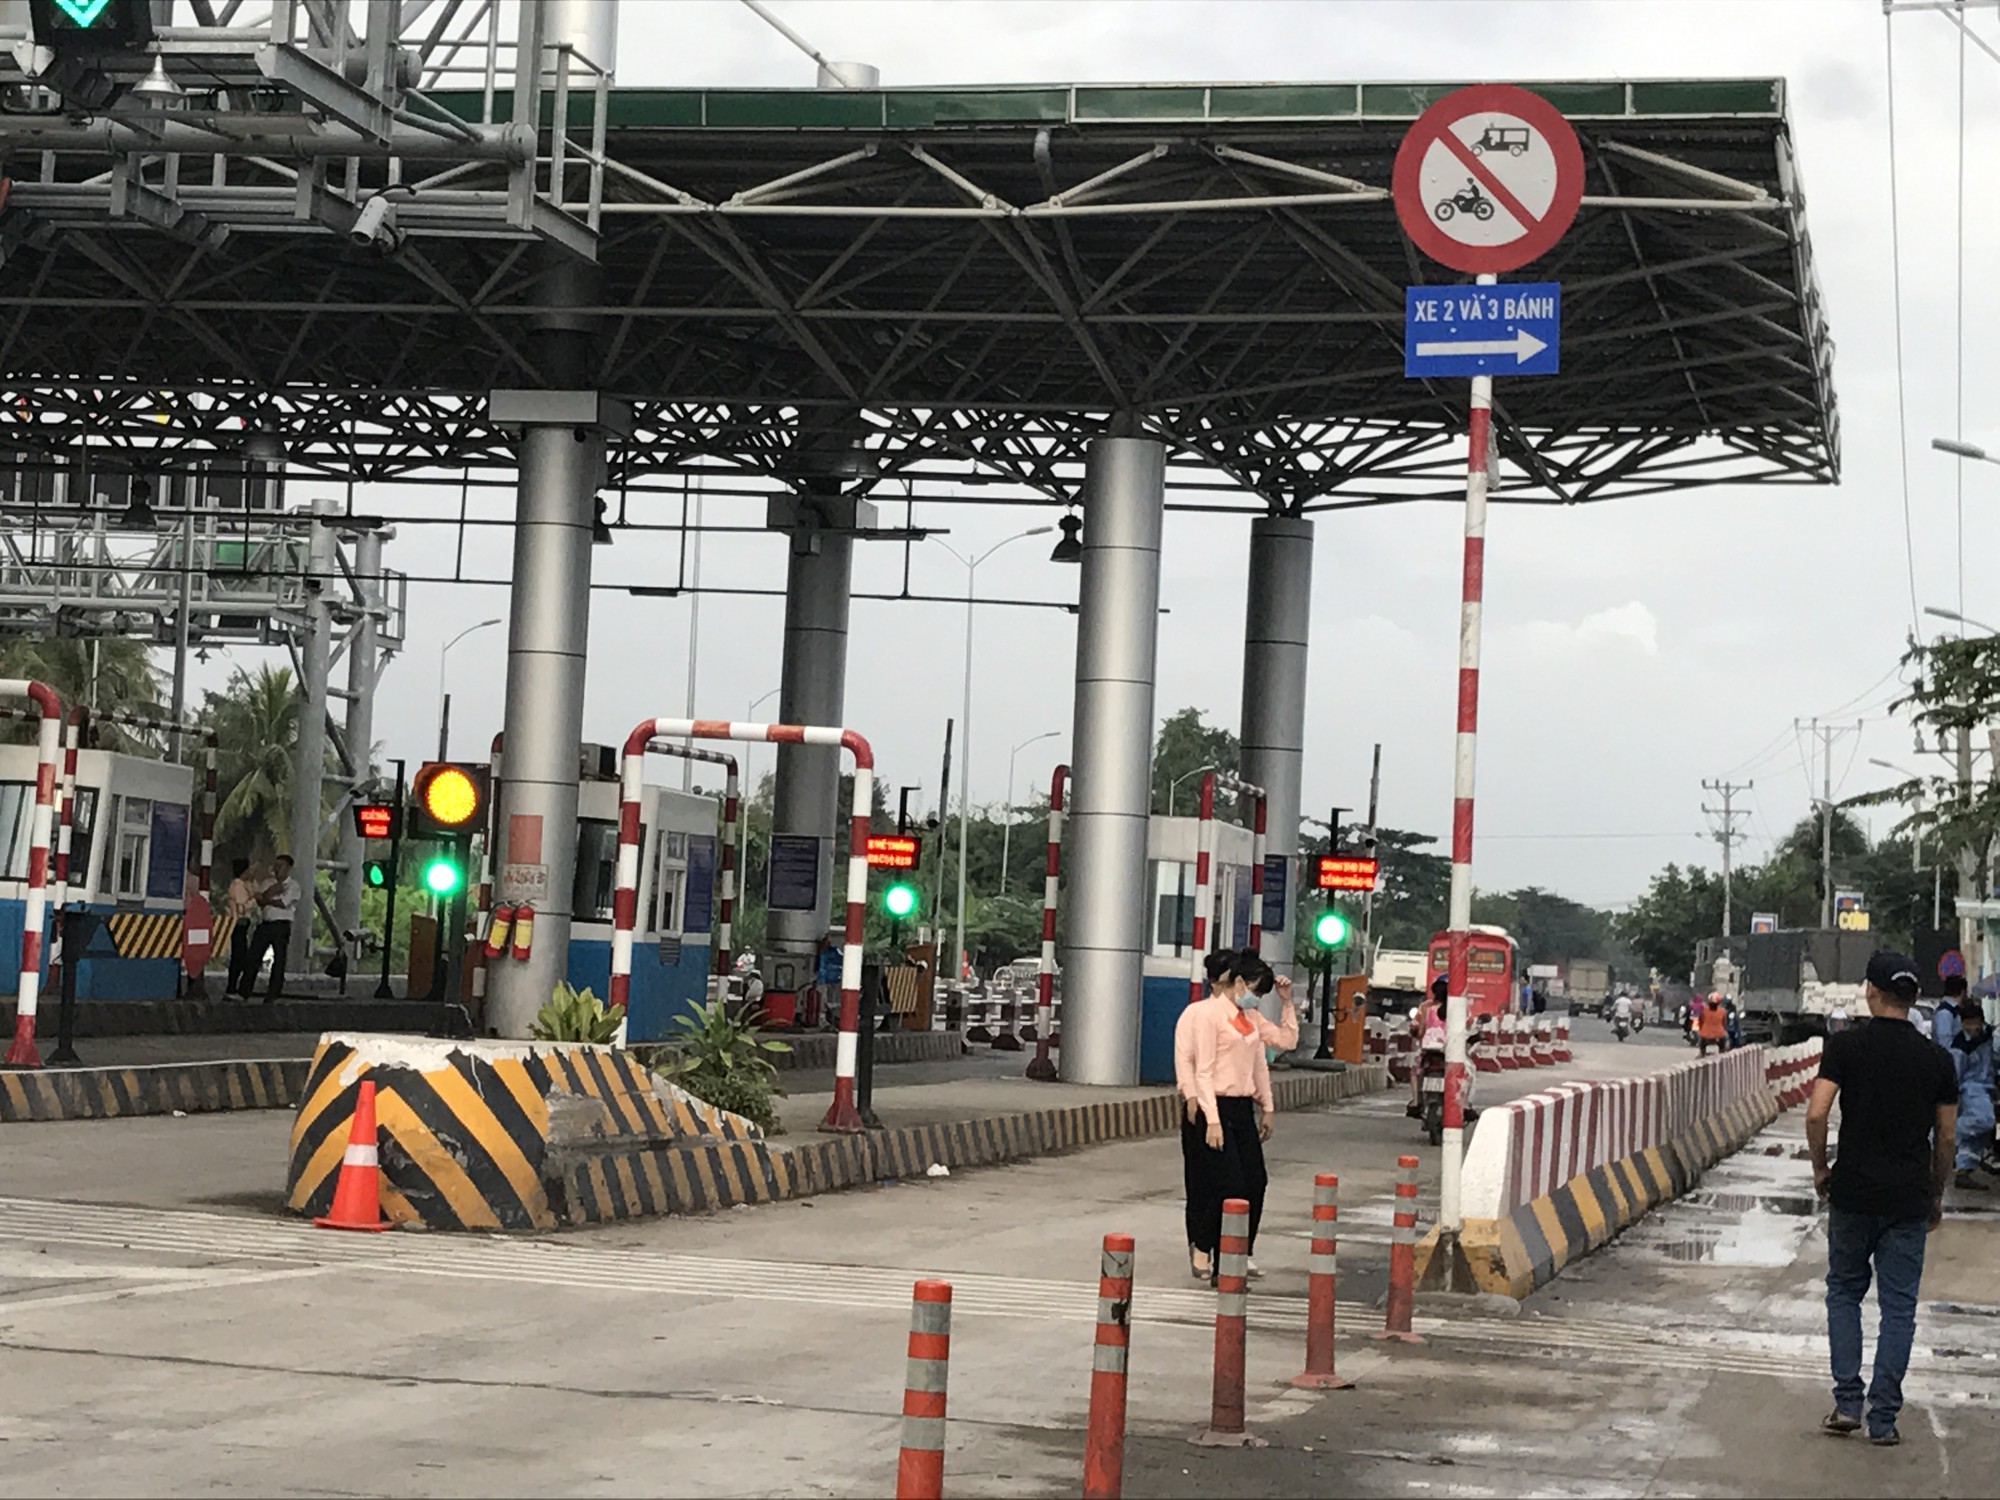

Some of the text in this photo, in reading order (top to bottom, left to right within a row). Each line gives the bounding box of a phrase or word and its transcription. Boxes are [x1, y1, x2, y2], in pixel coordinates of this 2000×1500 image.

[1414, 292, 1554, 322] XE 2 VÀ 3 BÁNH
